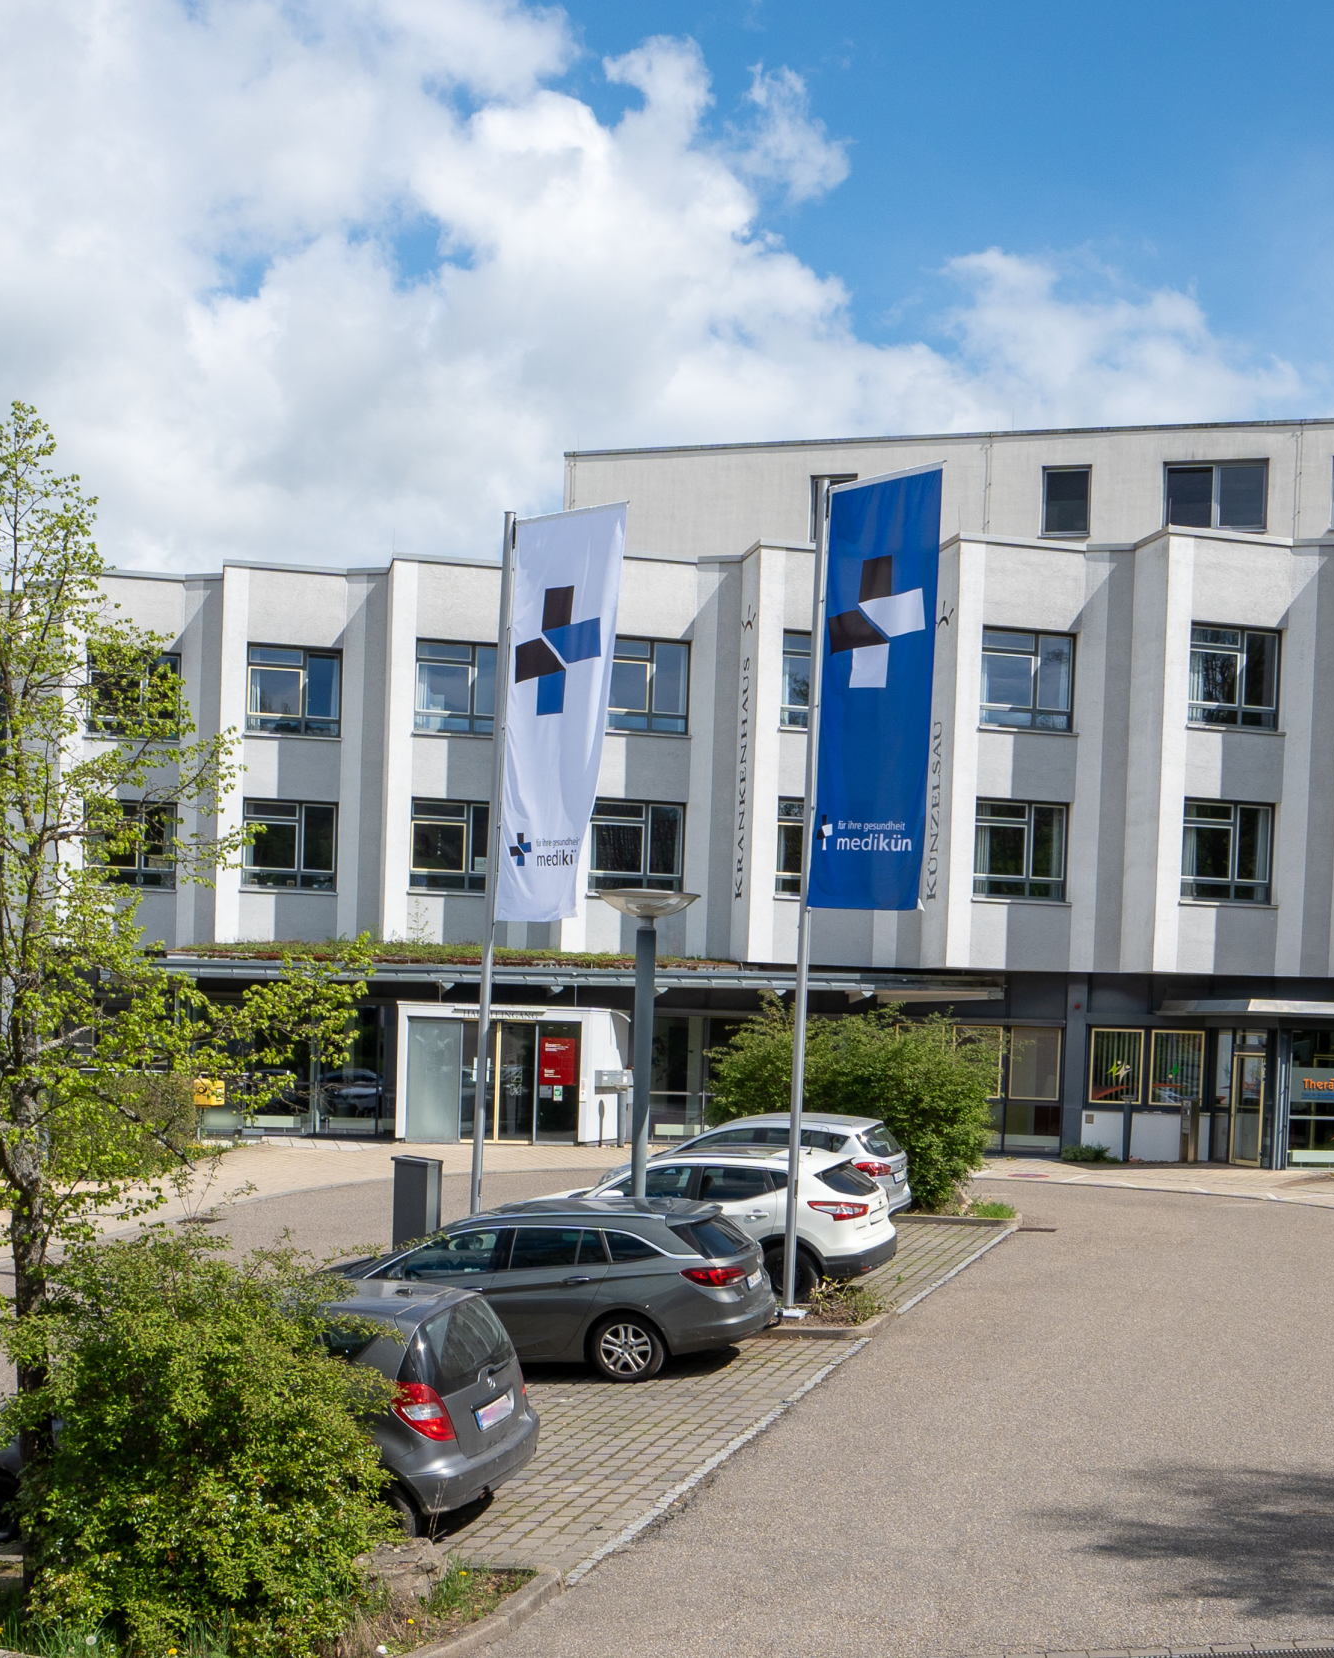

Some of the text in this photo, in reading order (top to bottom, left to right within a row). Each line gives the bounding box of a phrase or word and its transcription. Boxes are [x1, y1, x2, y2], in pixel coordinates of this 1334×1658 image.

[735, 657, 750, 900] KRANKENHAUS
[837, 820, 906, 832] für ihre gesundheit
[926, 721, 943, 902] KÜNZELSAU
[836, 833, 912, 851] medikün
